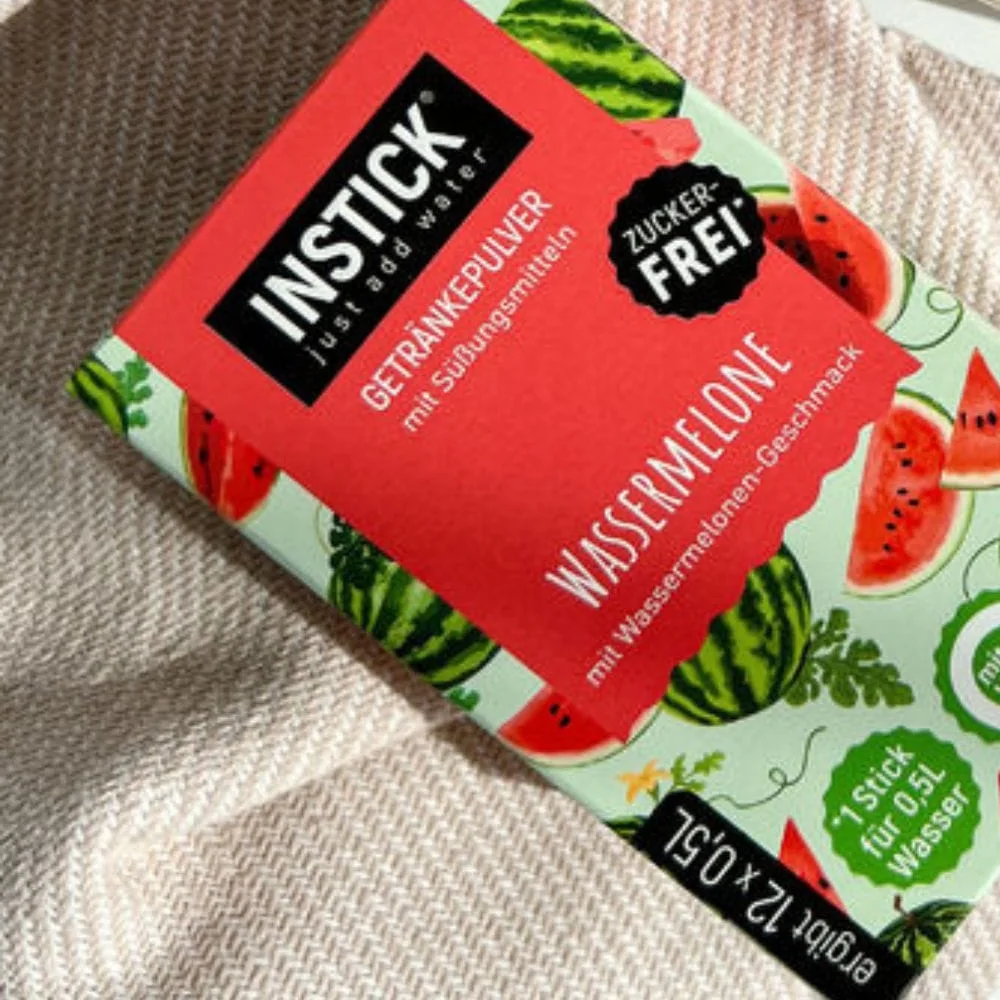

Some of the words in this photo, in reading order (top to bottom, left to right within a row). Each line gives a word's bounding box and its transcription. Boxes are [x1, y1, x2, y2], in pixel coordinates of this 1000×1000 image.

[304, 301, 363, 365] just
[366, 239, 411, 292] add
[417, 146, 487, 230] water
[622, 180, 722, 255] ZUCKER-
[359, 188, 553, 412] GETRÄNKEPULVER
[403, 393, 440, 432] mit
[433, 224, 577, 394] Süßungsmitteln
[544, 332, 793, 609] WASSERMELONE
[586, 646, 622, 688] mit
[611, 343, 864, 646] Wassermelonen-Geschmack
[852, 743, 914, 811] Stick
[859, 816, 900, 860] für
[893, 764, 945, 820] 0,5L
[663, 806, 737, 885] 0,5L
[736, 864, 760, 892] x
[887, 784, 970, 879] Wasser
[746, 882, 793, 934] 12
[792, 908, 877, 985] ergibt
